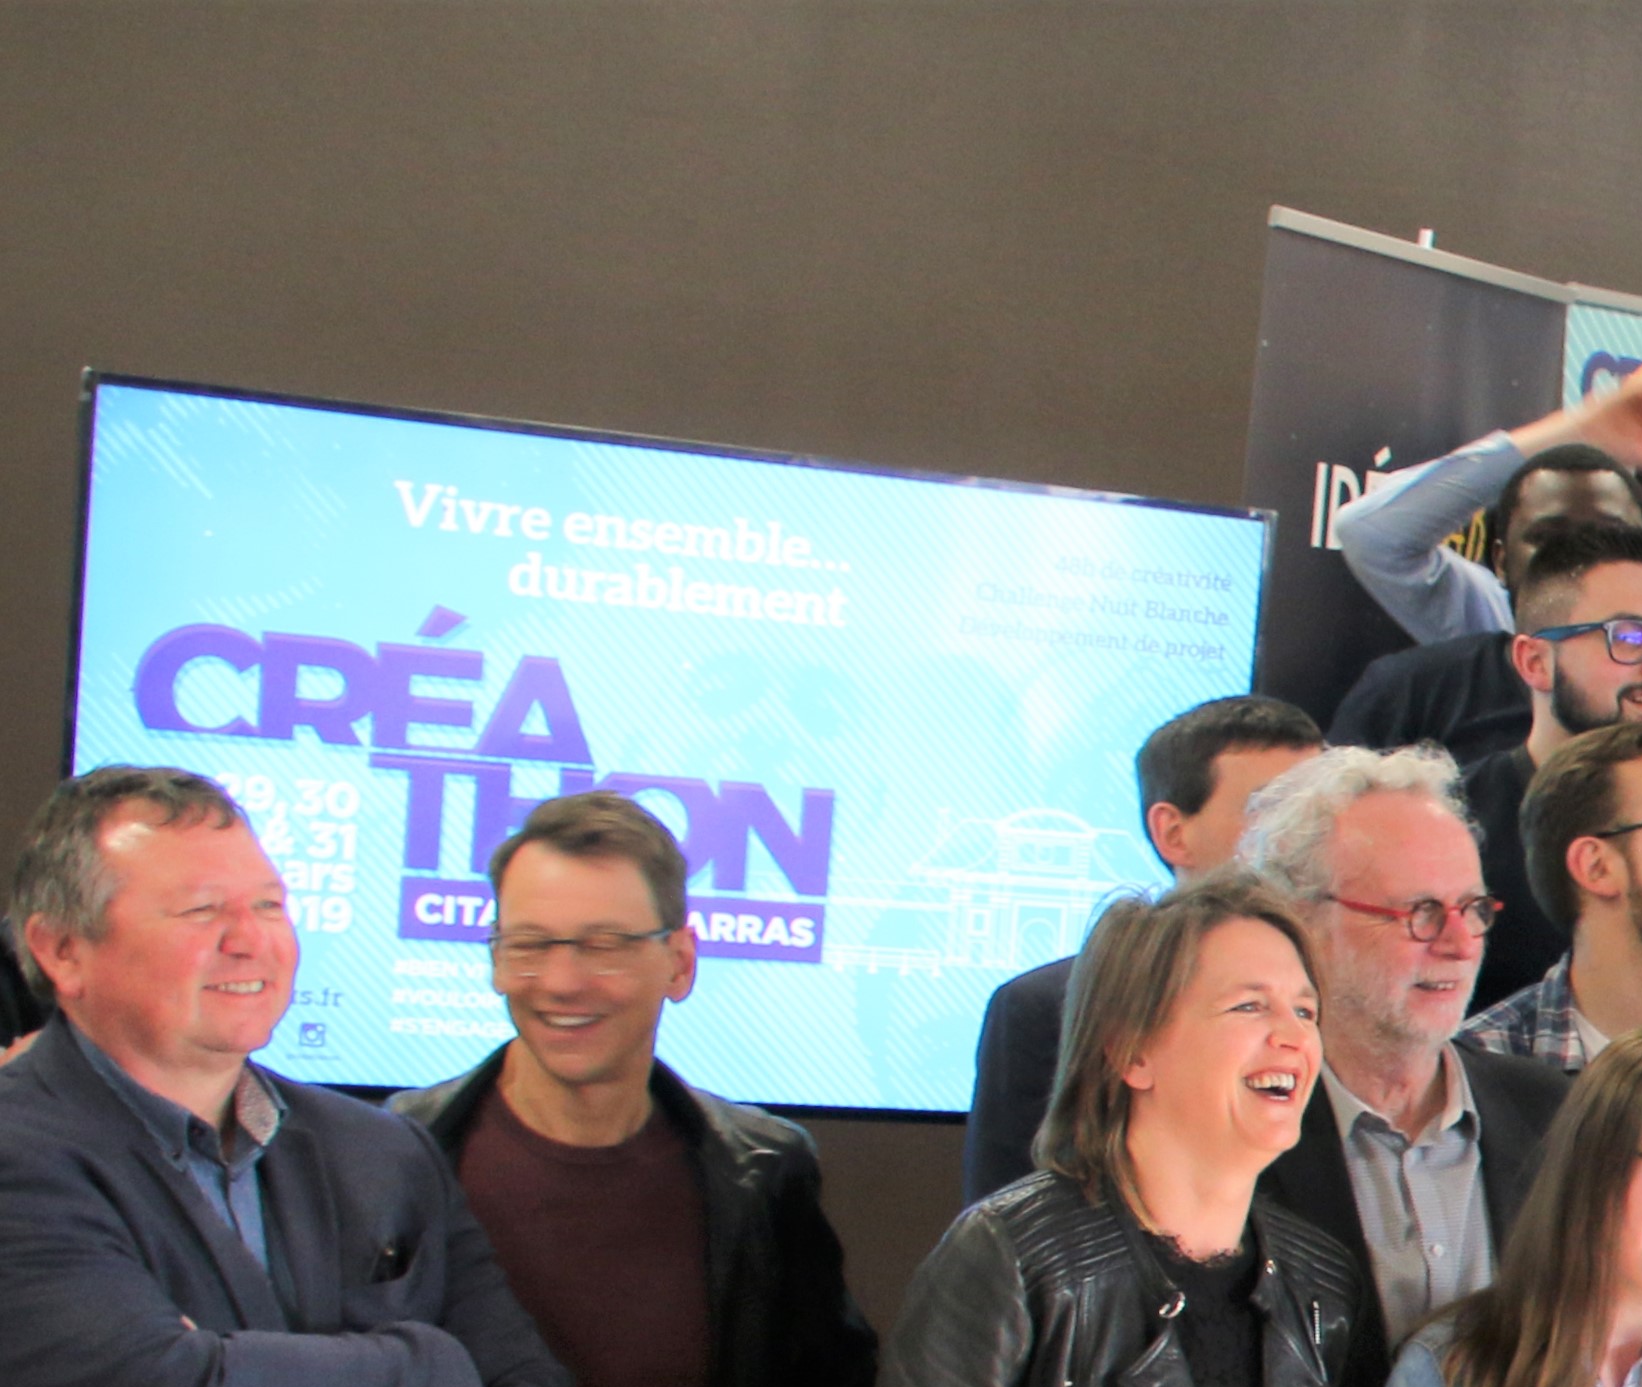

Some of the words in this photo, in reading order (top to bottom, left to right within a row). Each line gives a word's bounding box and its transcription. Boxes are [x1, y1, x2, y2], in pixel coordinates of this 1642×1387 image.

[393, 479, 553, 541] Vivre
[562, 510, 852, 573] ensemble...
[507, 551, 849, 628] durablement
[1131, 565, 1234, 593] créativité
[1090, 594, 1138, 617] Nuit
[1145, 600, 1231, 627] Blanche
[1134, 633, 1161, 654] de
[1164, 640, 1227, 662] projet
[133, 605, 596, 768] CRÉA
[294, 778, 361, 819] 30
[306, 821, 358, 861] 31
[282, 860, 356, 893] ars
[414, 893, 498, 927] CITA
